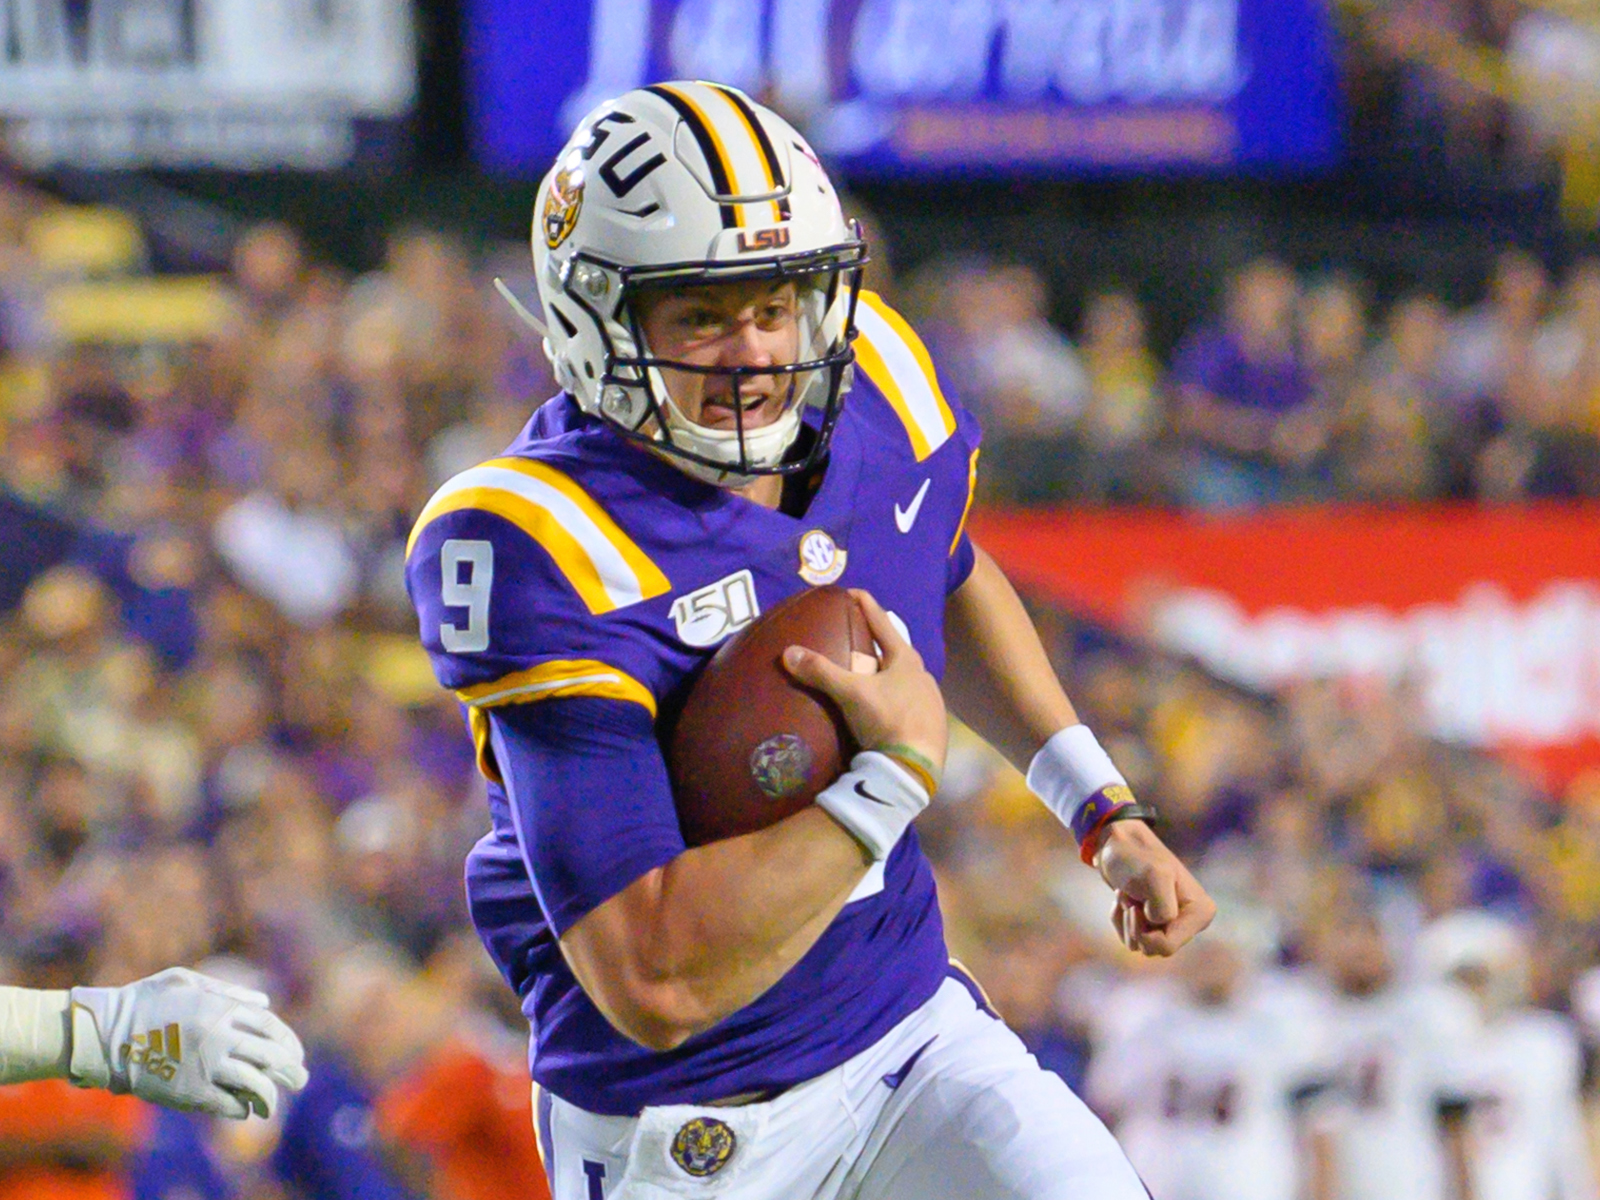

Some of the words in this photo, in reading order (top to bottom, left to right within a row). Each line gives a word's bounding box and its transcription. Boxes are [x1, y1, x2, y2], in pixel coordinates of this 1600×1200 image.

[737, 226, 792, 254] LSU
[439, 538, 495, 653] 9
[670, 570, 759, 647] 150
